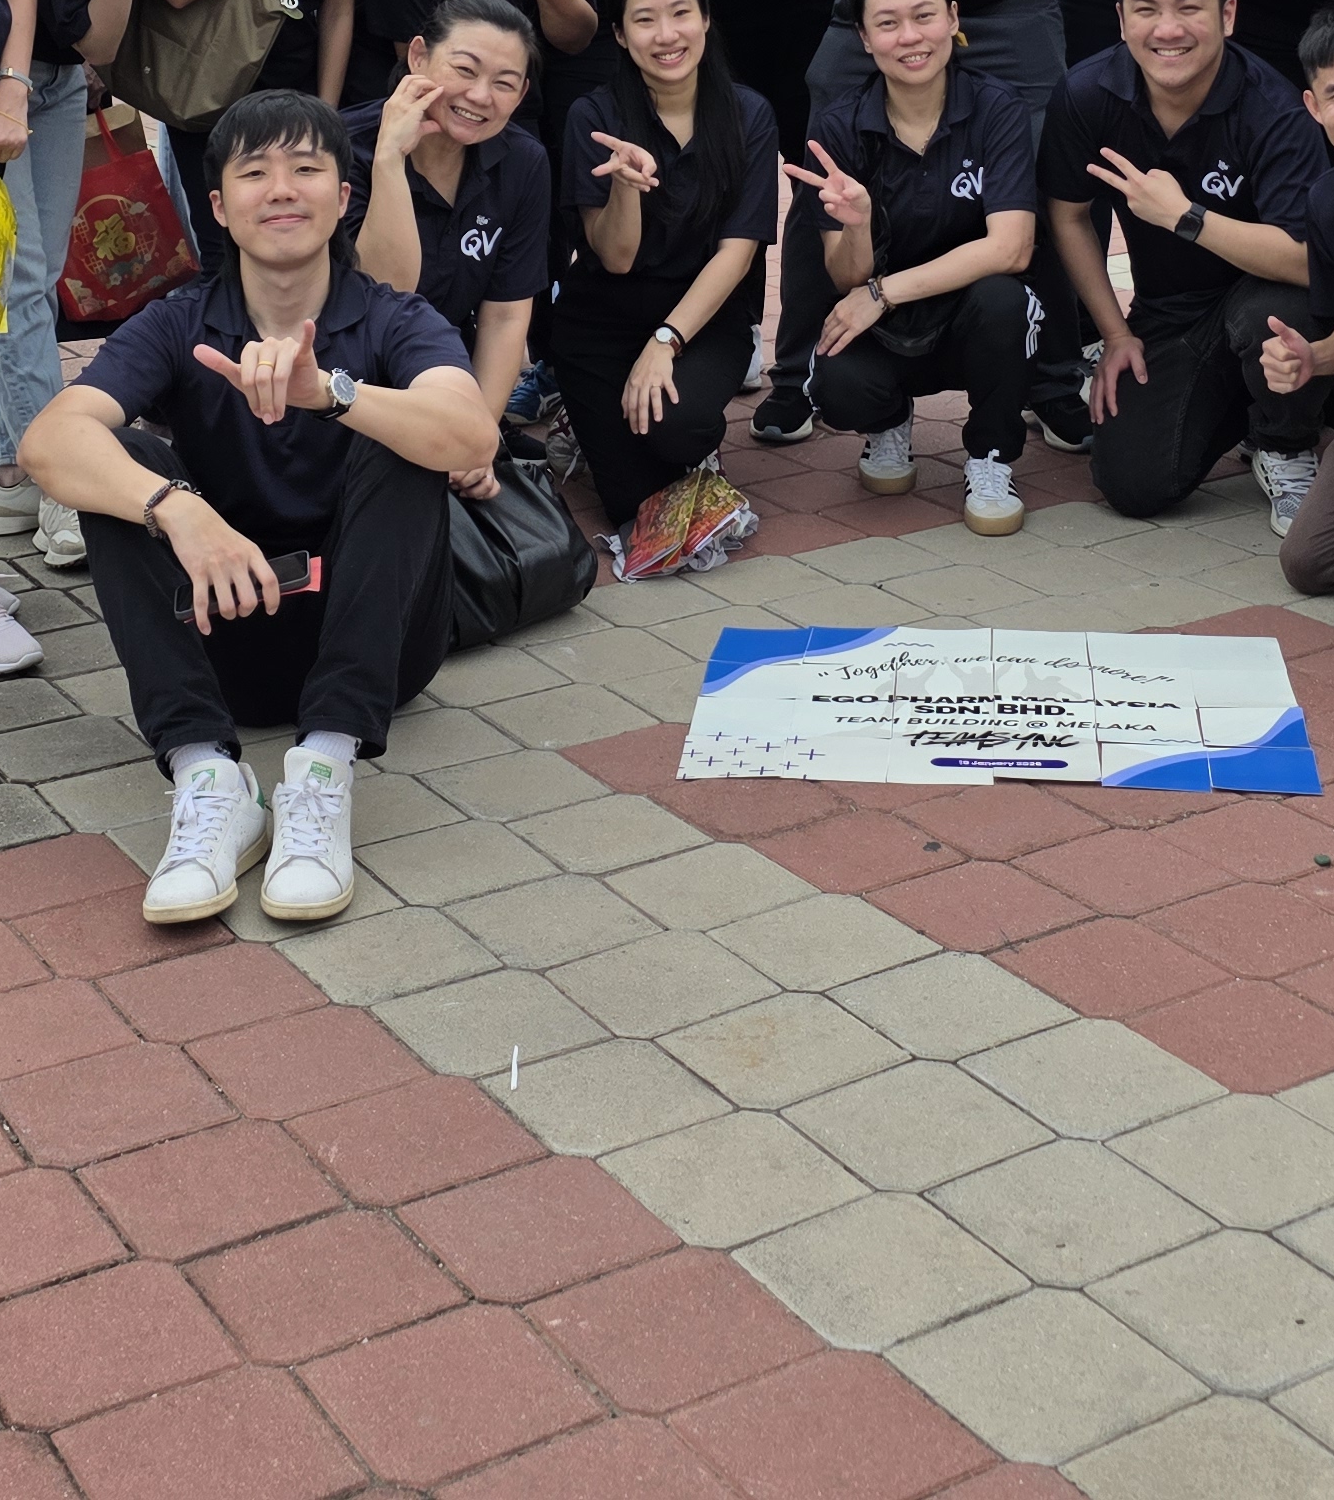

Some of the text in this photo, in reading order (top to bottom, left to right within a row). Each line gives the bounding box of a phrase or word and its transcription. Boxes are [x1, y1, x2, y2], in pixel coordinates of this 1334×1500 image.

[950, 166, 984, 201] QV
[1201, 171, 1245, 201] QV
[460, 226, 503, 261] QV
[995, 654, 1039, 665] can
[1043, 656, 1082, 669] do
[811, 694, 879, 703] EGO
[913, 702, 1075, 716] SDN. BHD.
[834, 716, 1157, 732] TEAM BUILDING @ MELAKA
